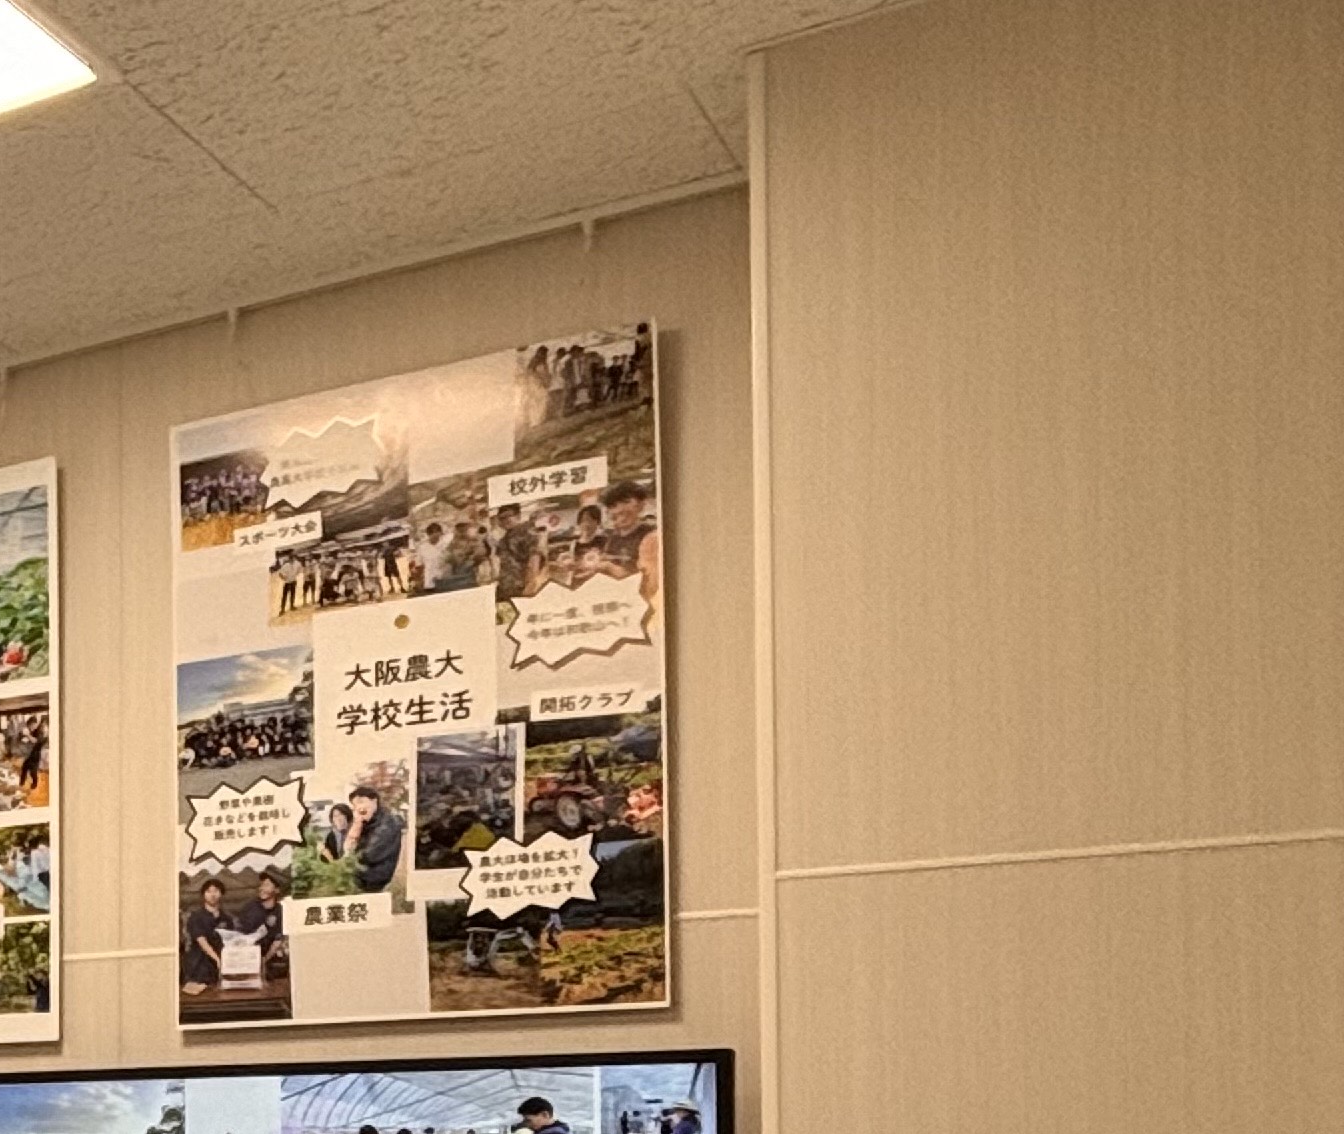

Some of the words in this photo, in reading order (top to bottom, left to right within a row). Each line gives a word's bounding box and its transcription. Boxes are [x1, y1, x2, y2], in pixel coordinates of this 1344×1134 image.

[508, 465, 590, 497] 校外学習
[344, 649, 464, 691] 大阪農大
[336, 689, 474, 736] 学校生活
[539, 688, 635, 714] 開拓クラブ
[303, 902, 370, 926] 農業祭
